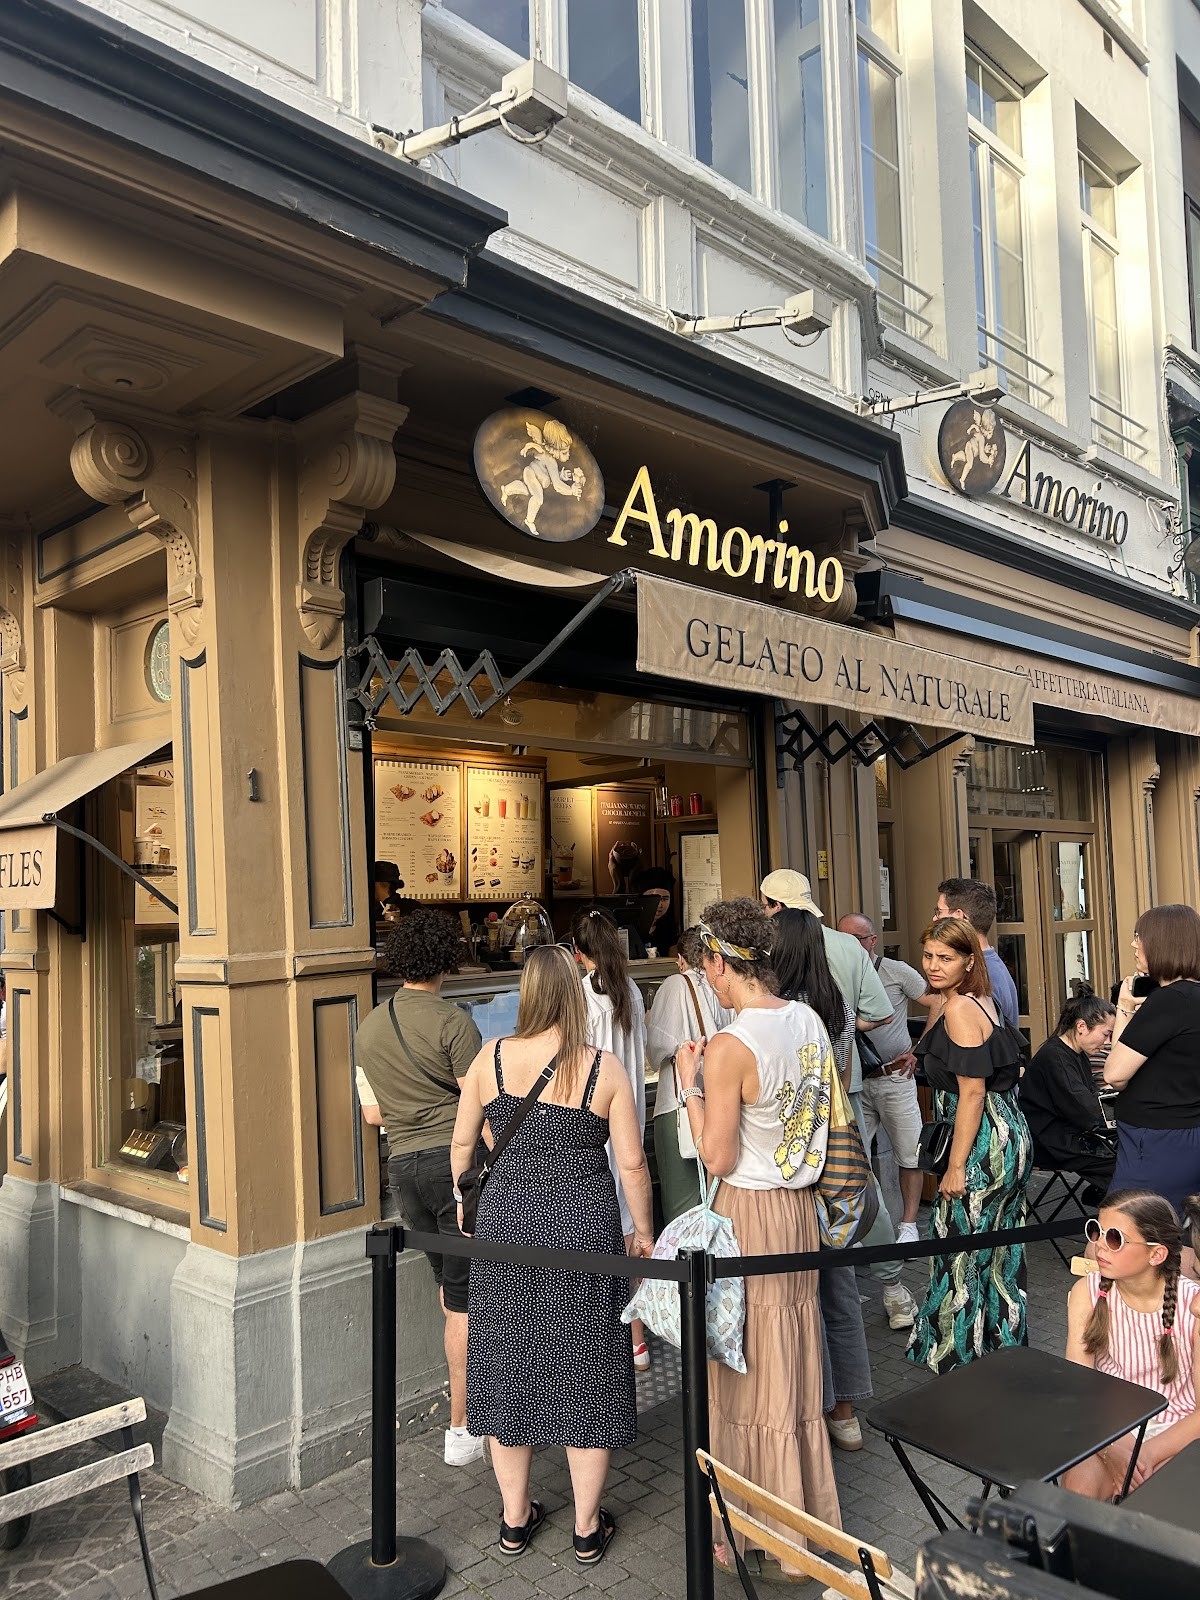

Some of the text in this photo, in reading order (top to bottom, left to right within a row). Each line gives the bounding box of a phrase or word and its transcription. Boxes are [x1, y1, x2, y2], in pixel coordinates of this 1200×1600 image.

[606, 464, 845, 603] Amorino
[1000, 440, 1129, 545] Amorino
[686, 618, 1012, 723] GELATO AL NATURALE
[2, 1388, 28, 1409] 557
